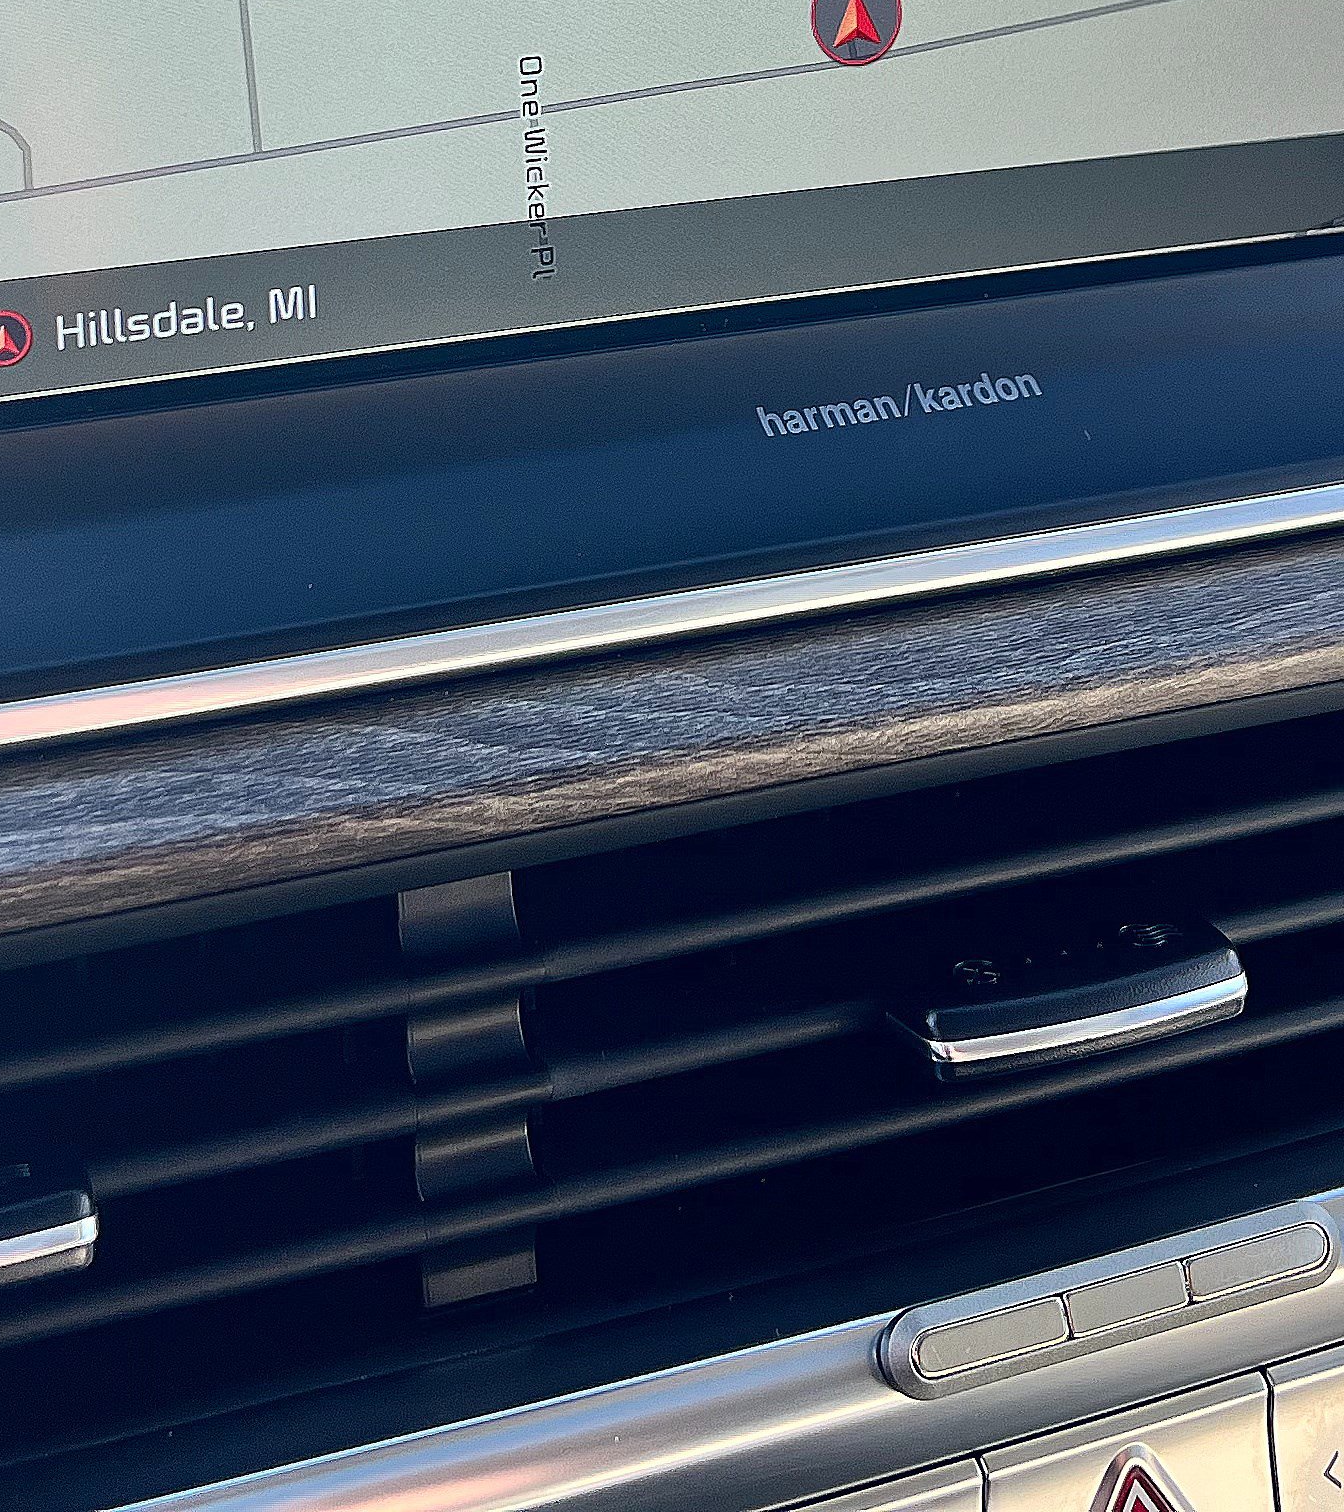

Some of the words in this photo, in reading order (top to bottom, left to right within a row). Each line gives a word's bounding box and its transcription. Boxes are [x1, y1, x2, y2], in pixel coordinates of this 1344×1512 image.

[519, 56, 542, 117] One
[524, 128, 550, 236] Wicker
[531, 246, 556, 279] Pl
[56, 294, 256, 353] Hillsdale,
[268, 283, 318, 324] MI
